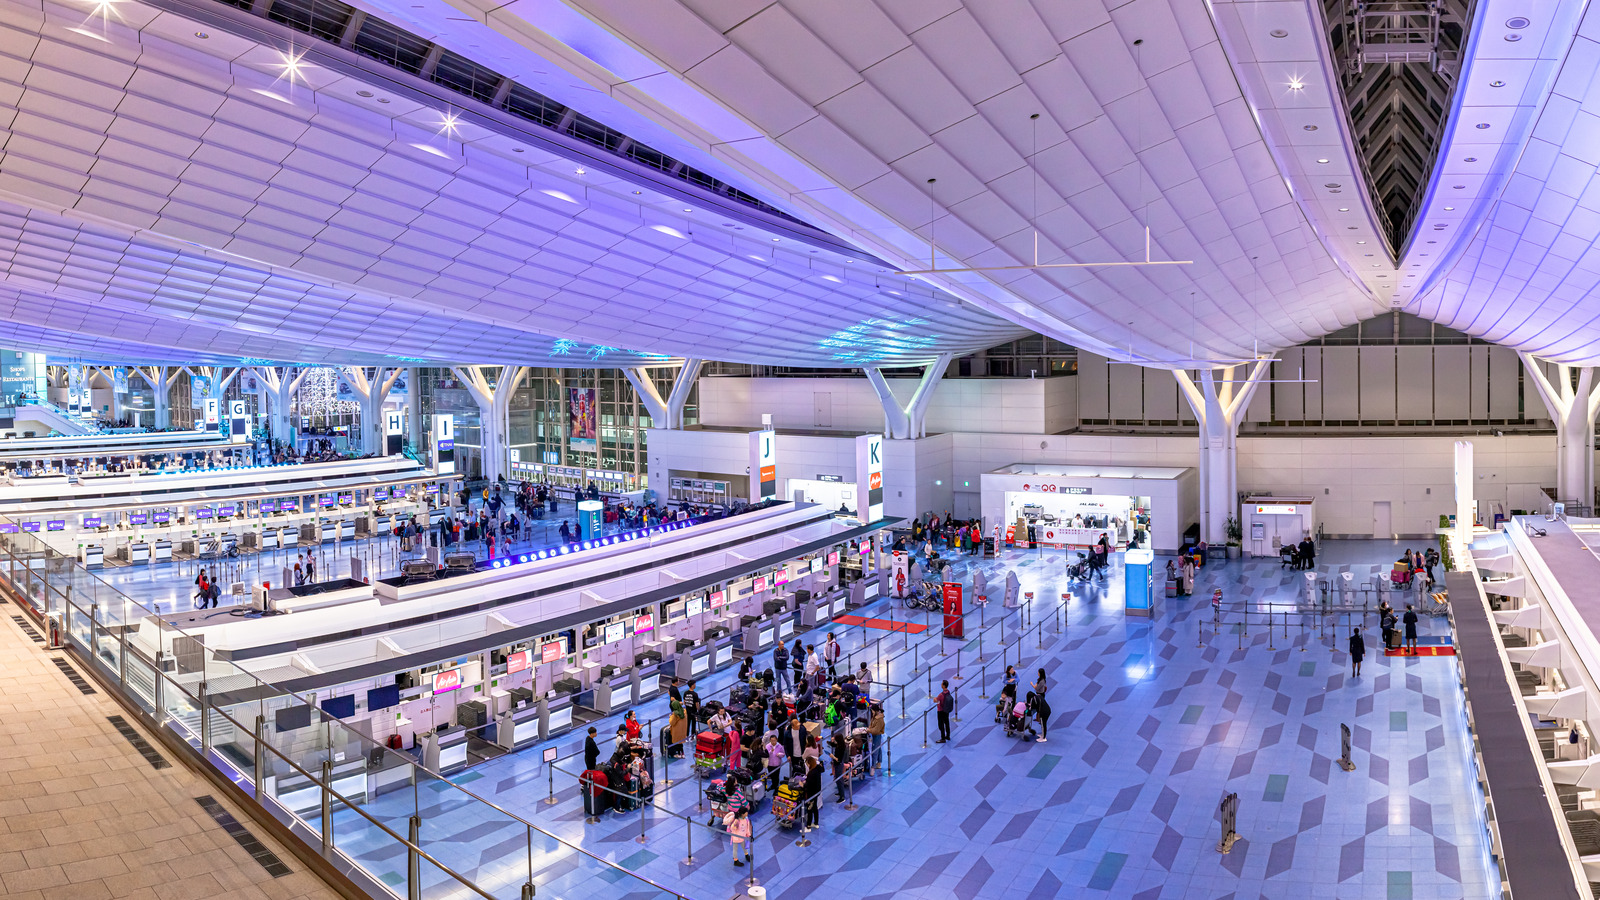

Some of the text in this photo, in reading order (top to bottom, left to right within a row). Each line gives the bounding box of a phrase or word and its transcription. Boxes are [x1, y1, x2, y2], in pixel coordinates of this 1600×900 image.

[209, 402, 215, 412] F
[234, 404, 243, 414] G
[390, 415, 399, 429] H
[444, 421, 447, 435] I
[764, 438, 770, 458] J
[870, 442, 880, 464] K
